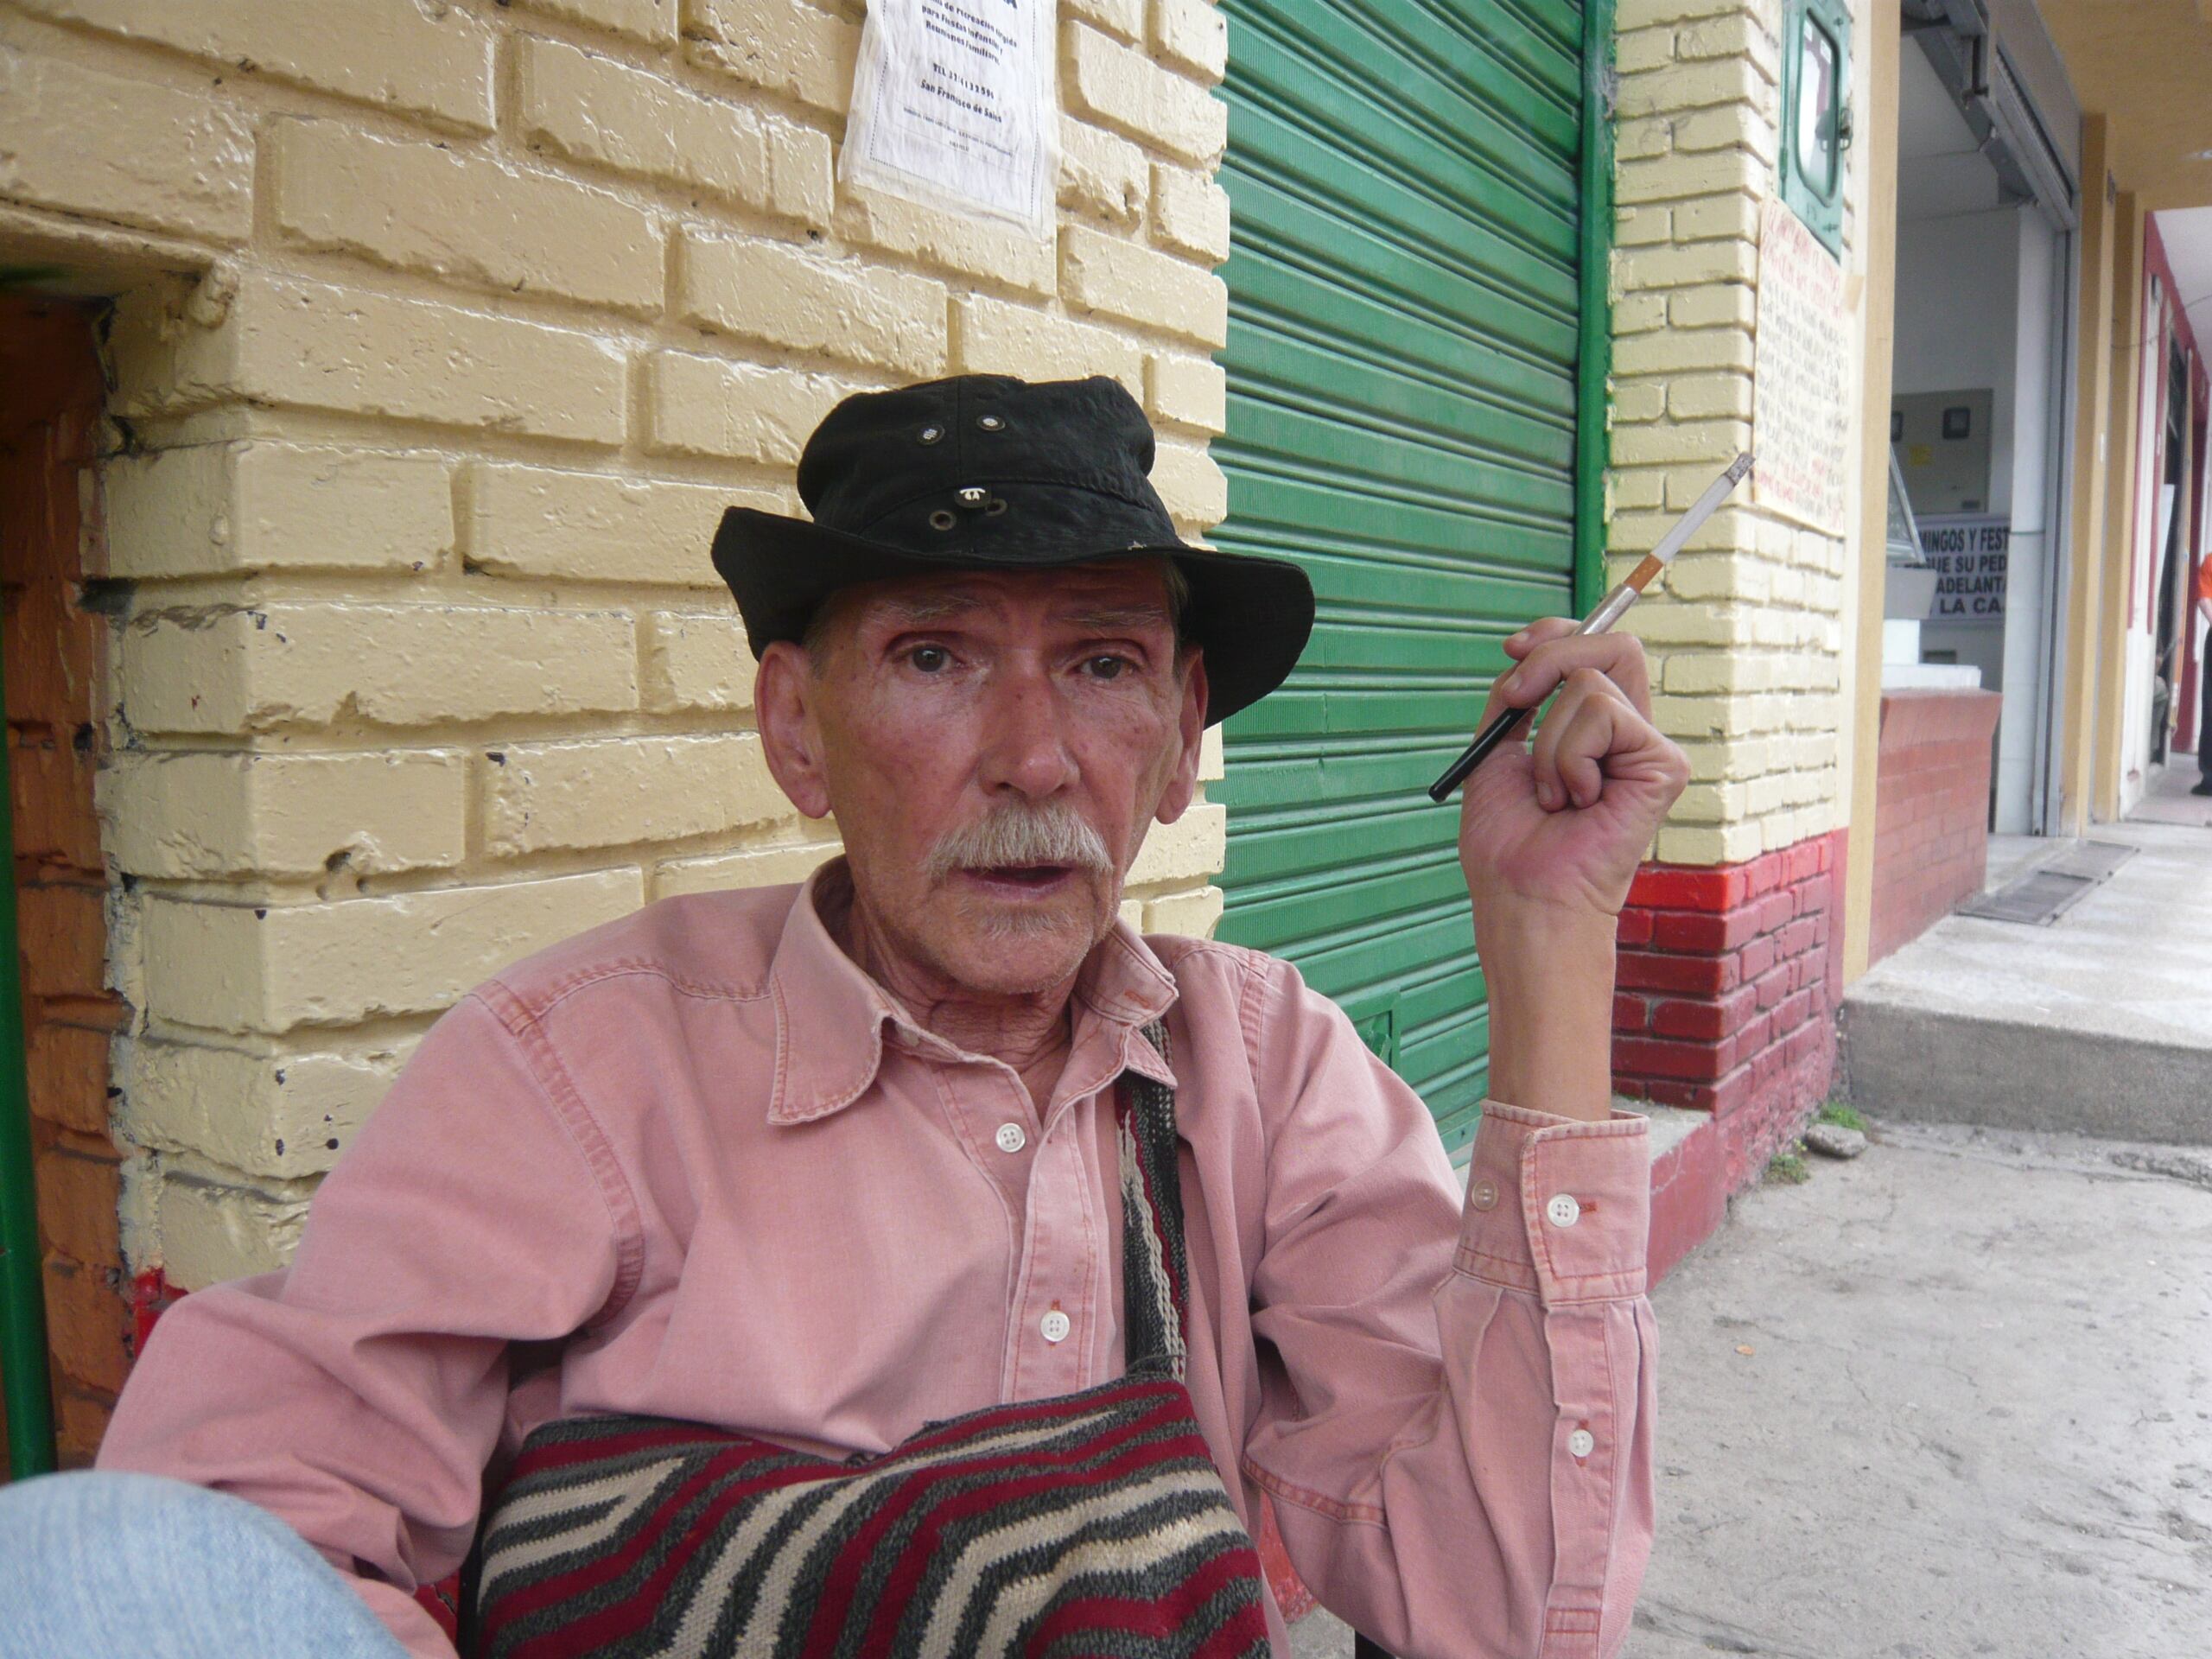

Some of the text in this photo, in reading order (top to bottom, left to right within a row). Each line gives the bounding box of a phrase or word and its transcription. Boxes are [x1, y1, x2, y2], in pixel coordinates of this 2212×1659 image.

[921, 4, 939, 19] para
[920, 79, 936, 94] San
[973, 103, 983, 114] de
[1968, 527, 1977, 551] Y
[1955, 555, 1974, 573] SU
[1980, 554, 2006, 573] PED
[1940, 596, 2005, 614] LA CA
